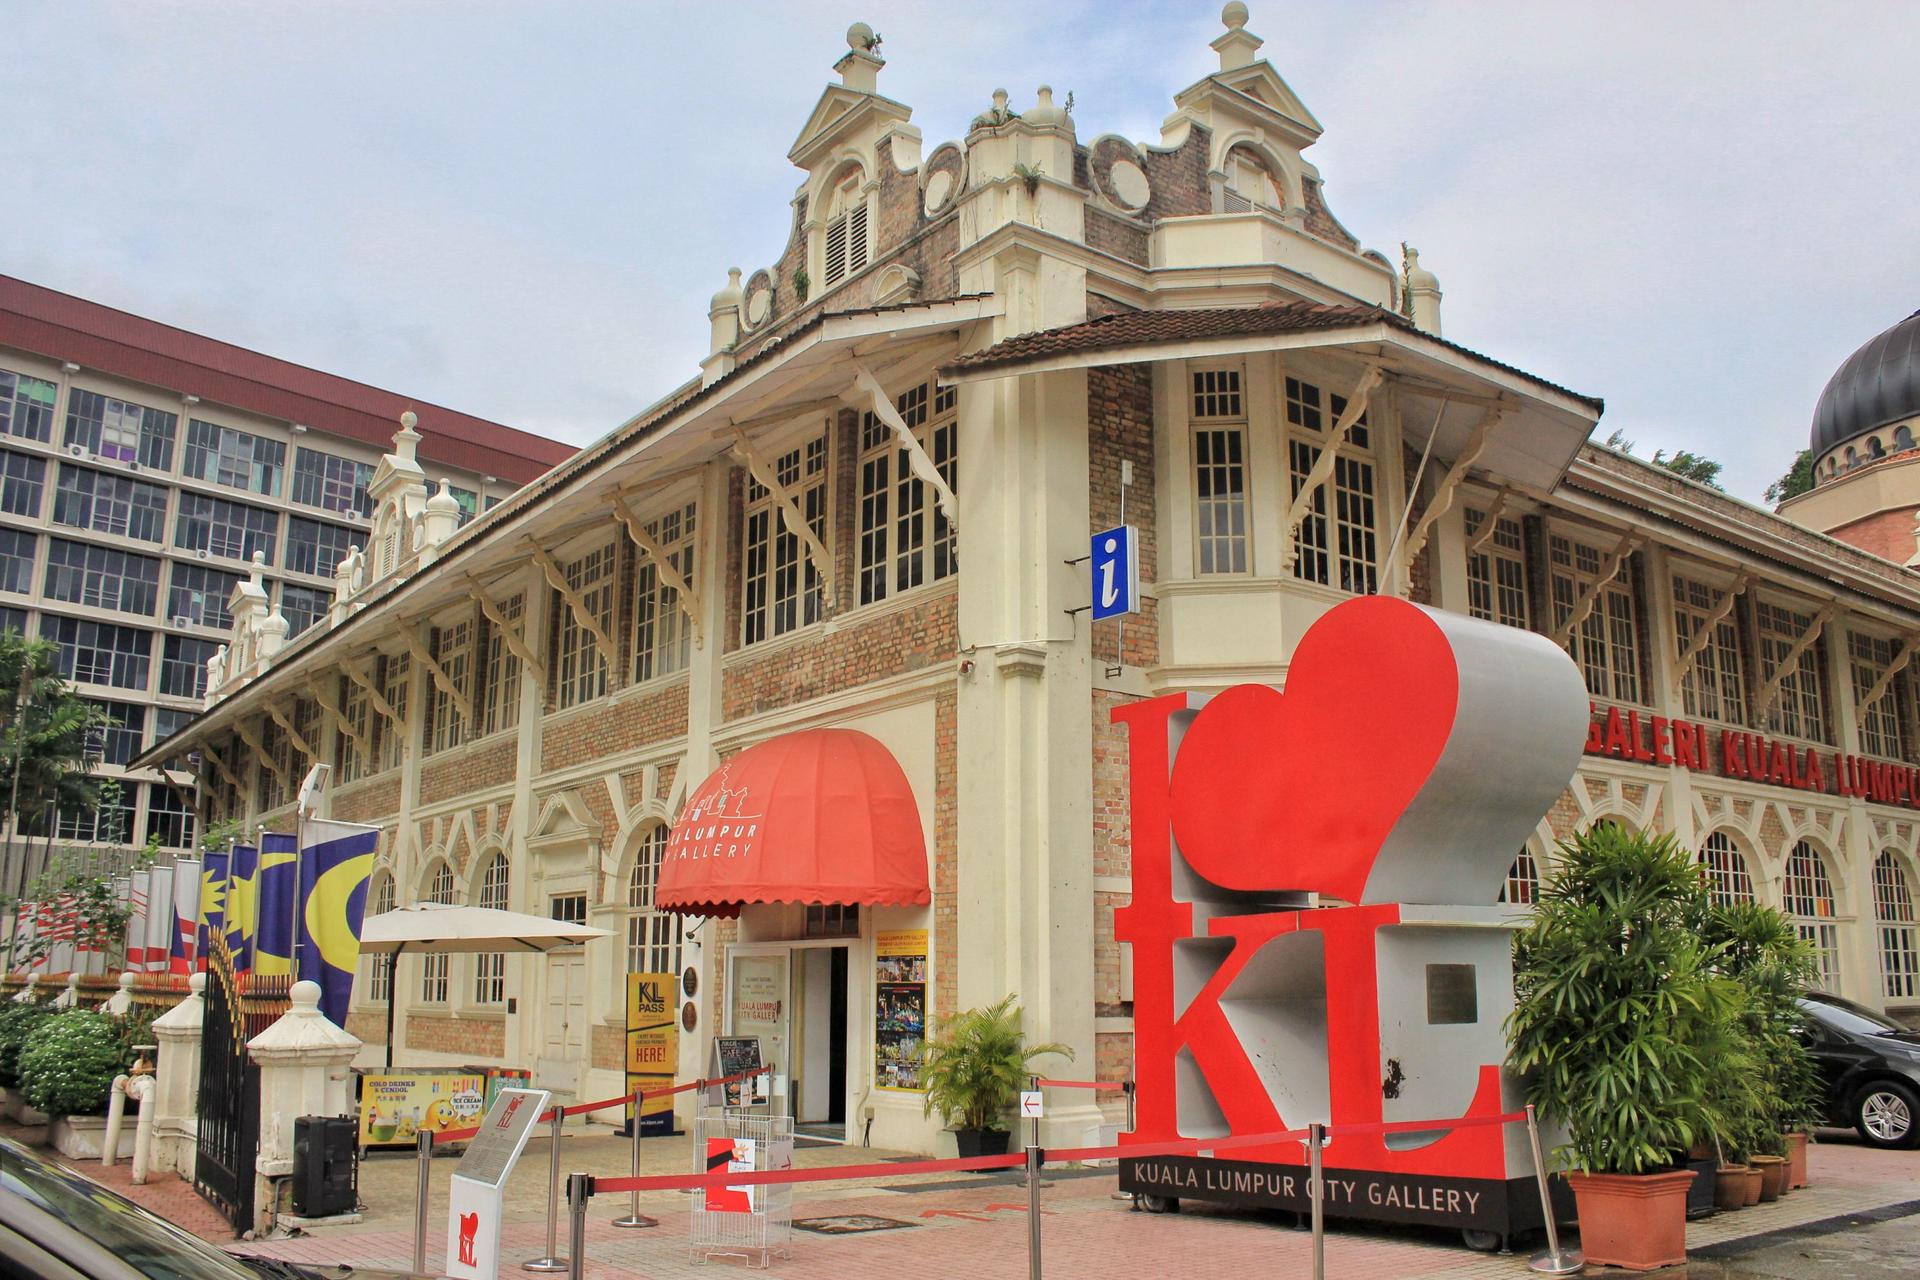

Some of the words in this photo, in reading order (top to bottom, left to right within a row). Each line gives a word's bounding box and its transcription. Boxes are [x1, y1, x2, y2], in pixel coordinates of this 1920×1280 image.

[1585, 700, 1708, 770] GALERI
[1721, 729, 1824, 792] KUALA
[684, 825, 757, 841] LUMPUR
[638, 982, 664, 1002] KL
[638, 1003, 665, 1013] PASS
[1114, 902, 1507, 1181] KL
[637, 1047, 666, 1063] HERE!
[1135, 1162, 1198, 1188] KUALA
[1206, 1169, 1296, 1198] LUMPUR
[1367, 1182, 1481, 1216] GALLERY
